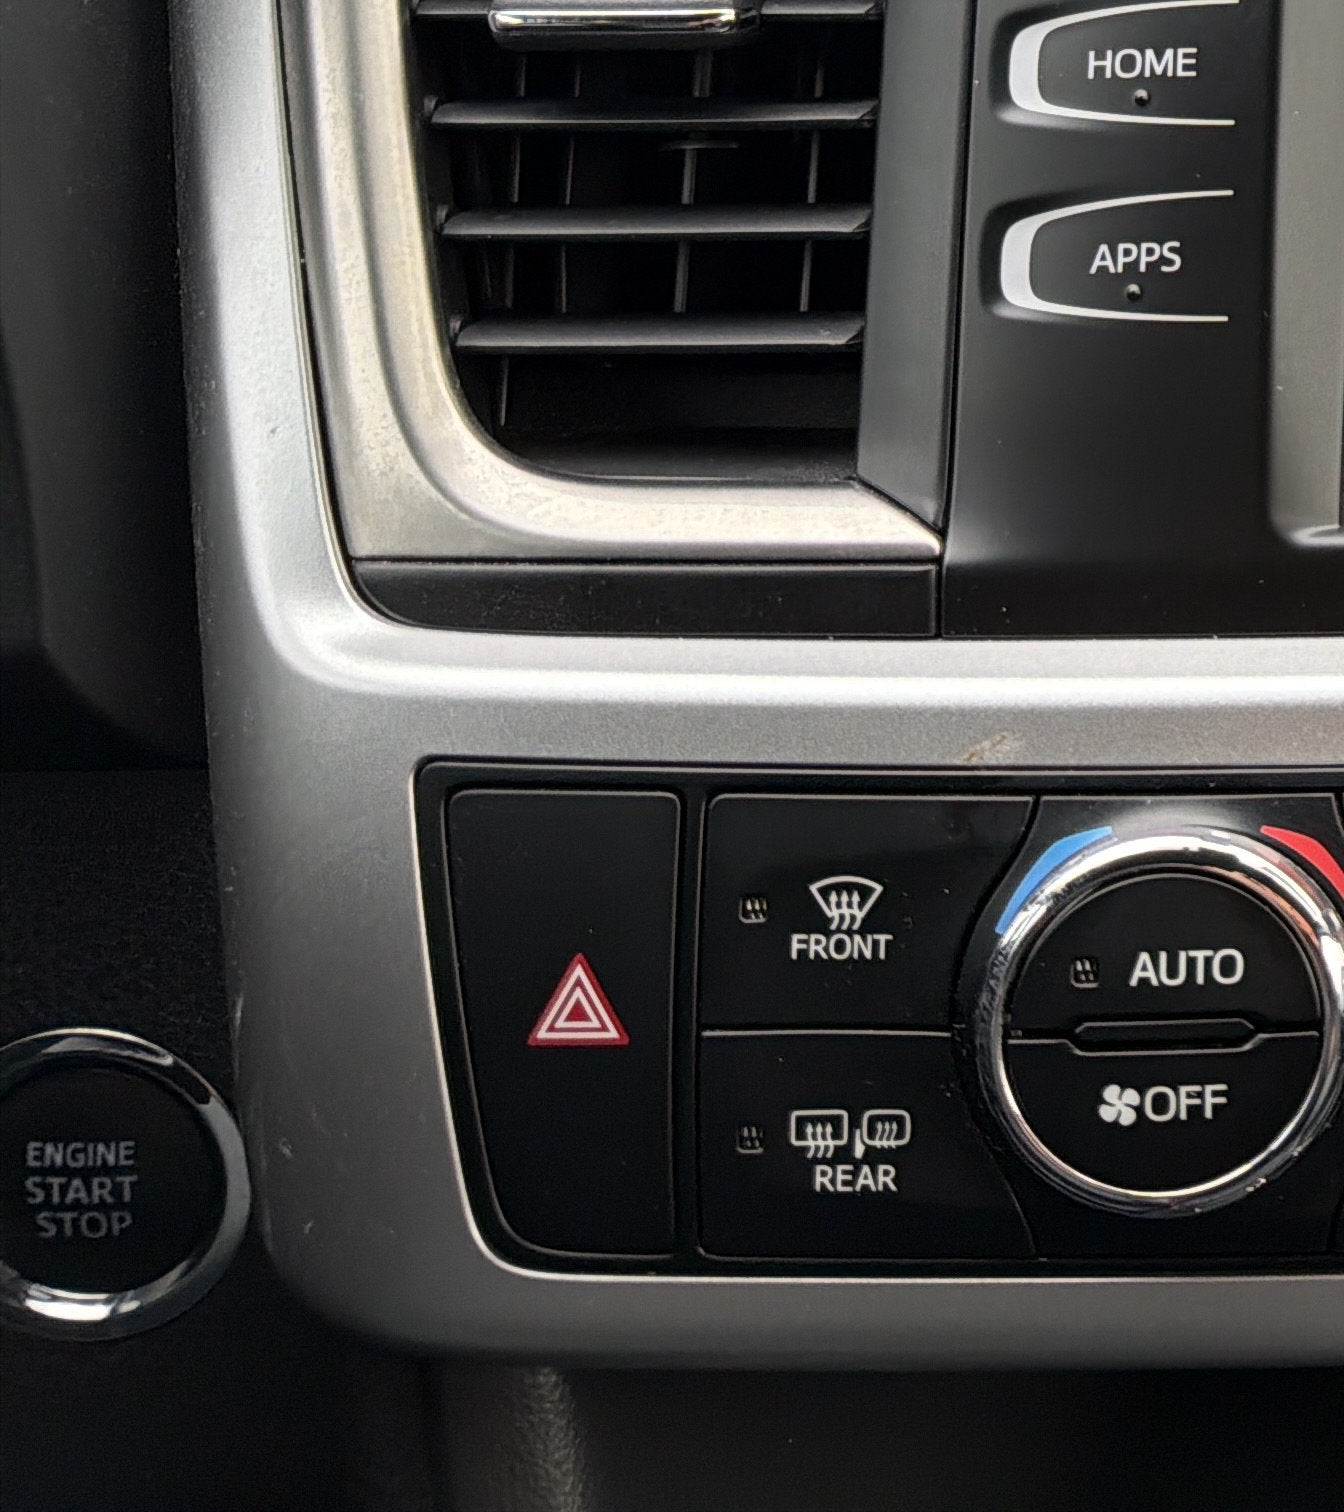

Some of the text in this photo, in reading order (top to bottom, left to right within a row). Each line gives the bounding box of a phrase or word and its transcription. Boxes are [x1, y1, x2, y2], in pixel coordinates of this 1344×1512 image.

[1087, 47, 1198, 80] HOME
[1089, 241, 1182, 275] APPS
[791, 933, 893, 960] FRONT
[1129, 948, 1244, 987] AUTO
[1144, 1083, 1228, 1122] OFF
[26, 1141, 135, 1168] ENGINE
[24, 1175, 138, 1204] START
[815, 1164, 898, 1192] REAR
[36, 1211, 133, 1238] STOP
